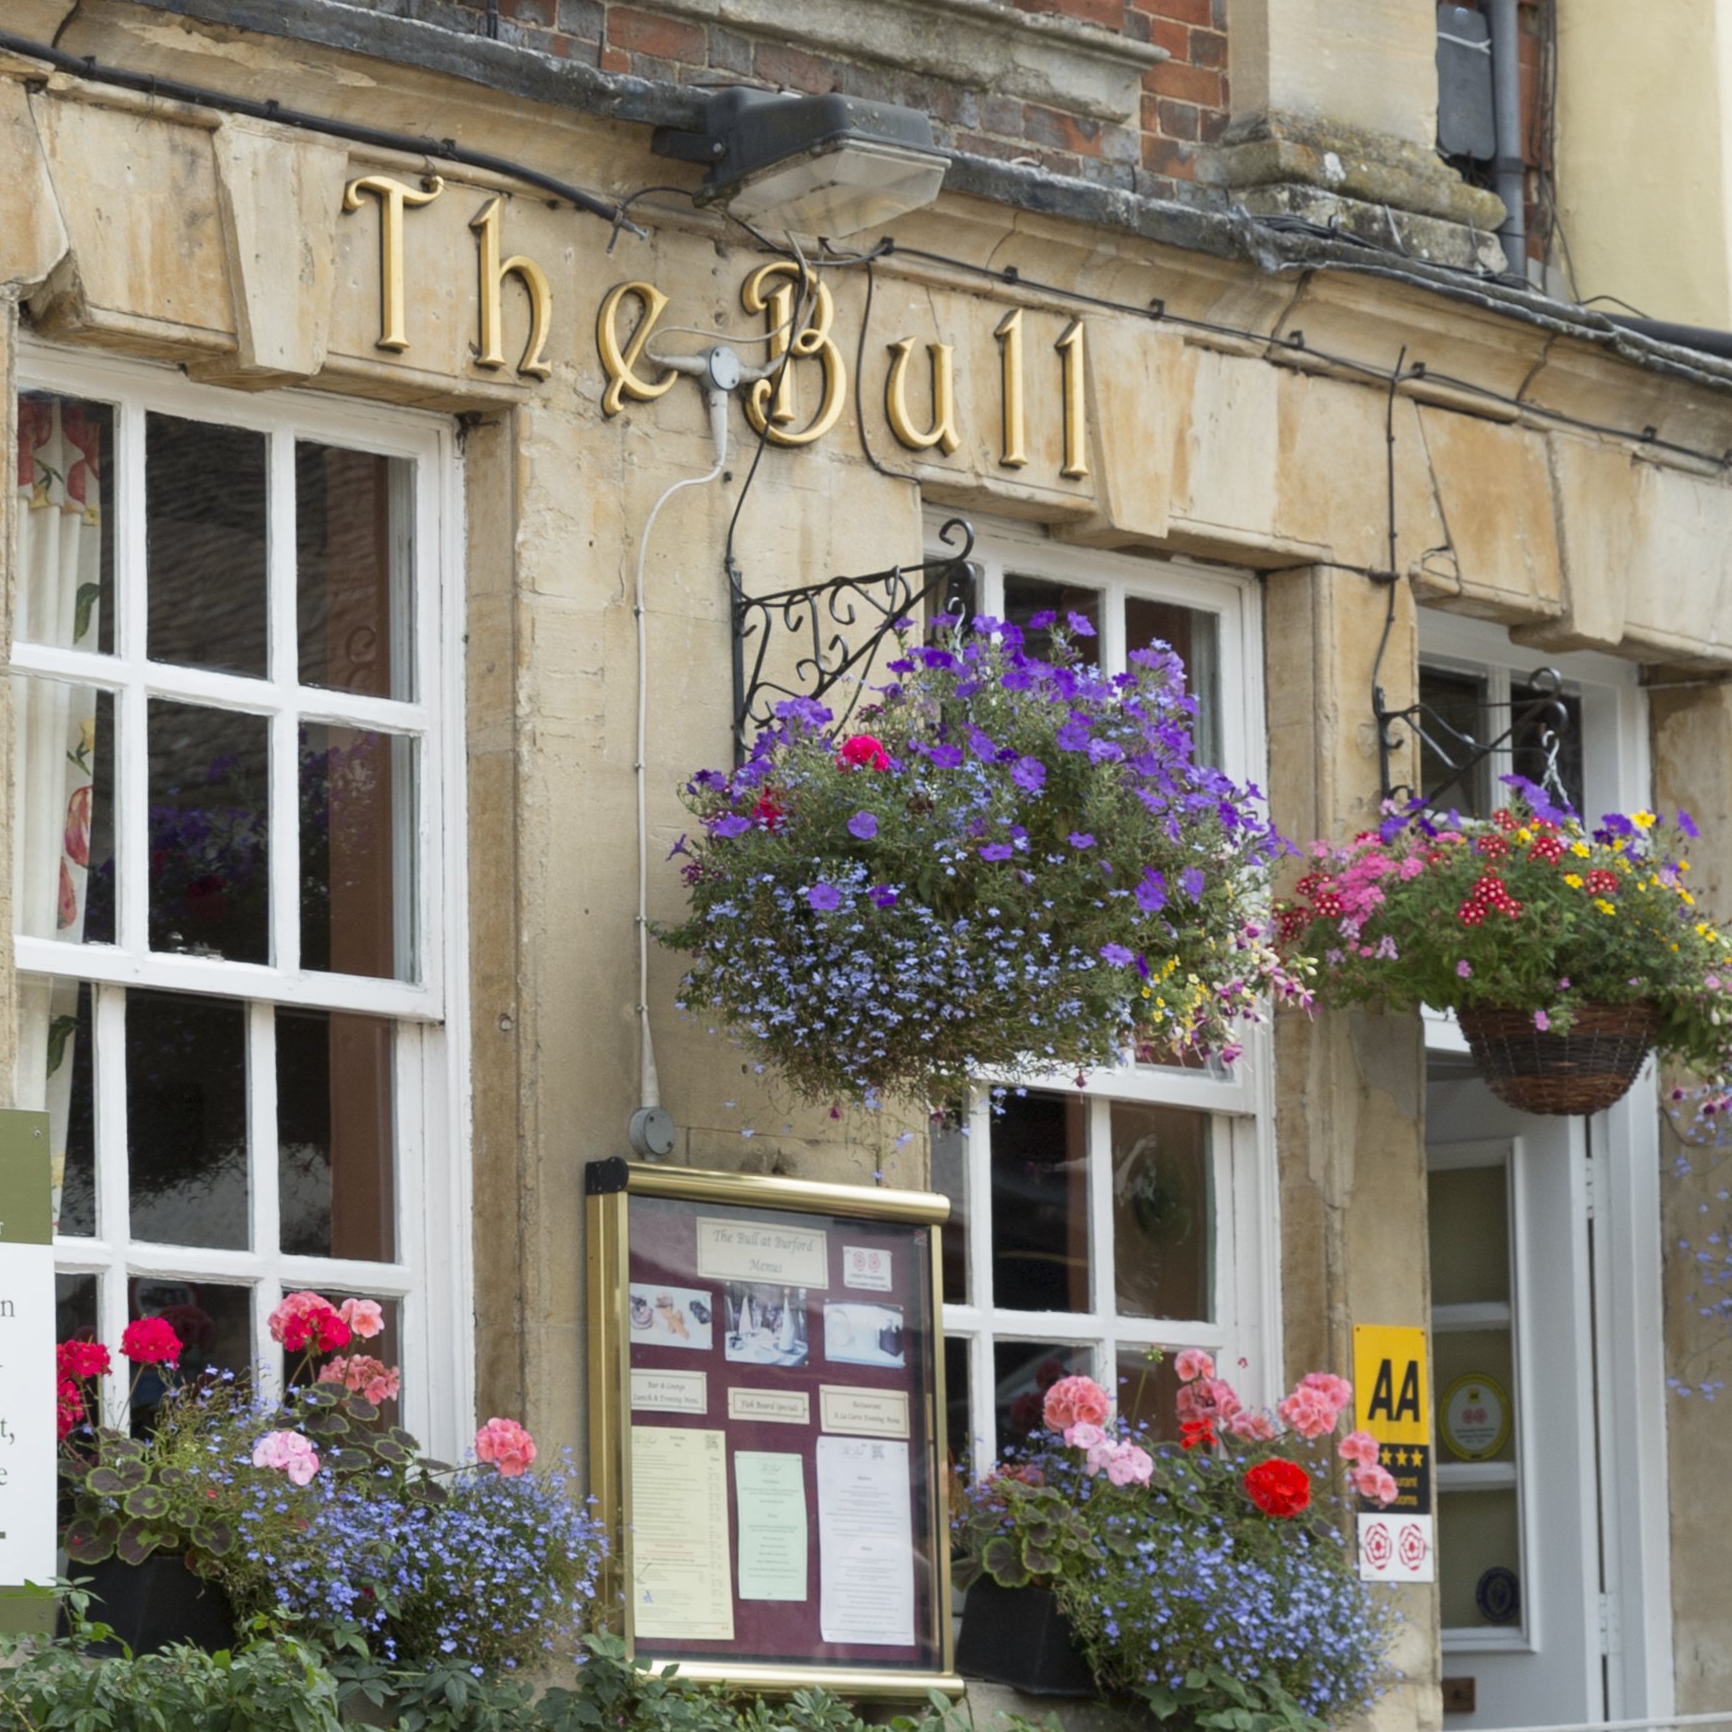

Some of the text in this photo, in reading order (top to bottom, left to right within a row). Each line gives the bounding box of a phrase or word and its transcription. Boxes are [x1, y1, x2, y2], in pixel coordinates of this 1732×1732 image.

[341, 174, 1090, 481] The Bull
[713, 1228, 733, 1244] The
[736, 1231, 760, 1247] Bull
[1367, 1358, 1420, 1422] AA
